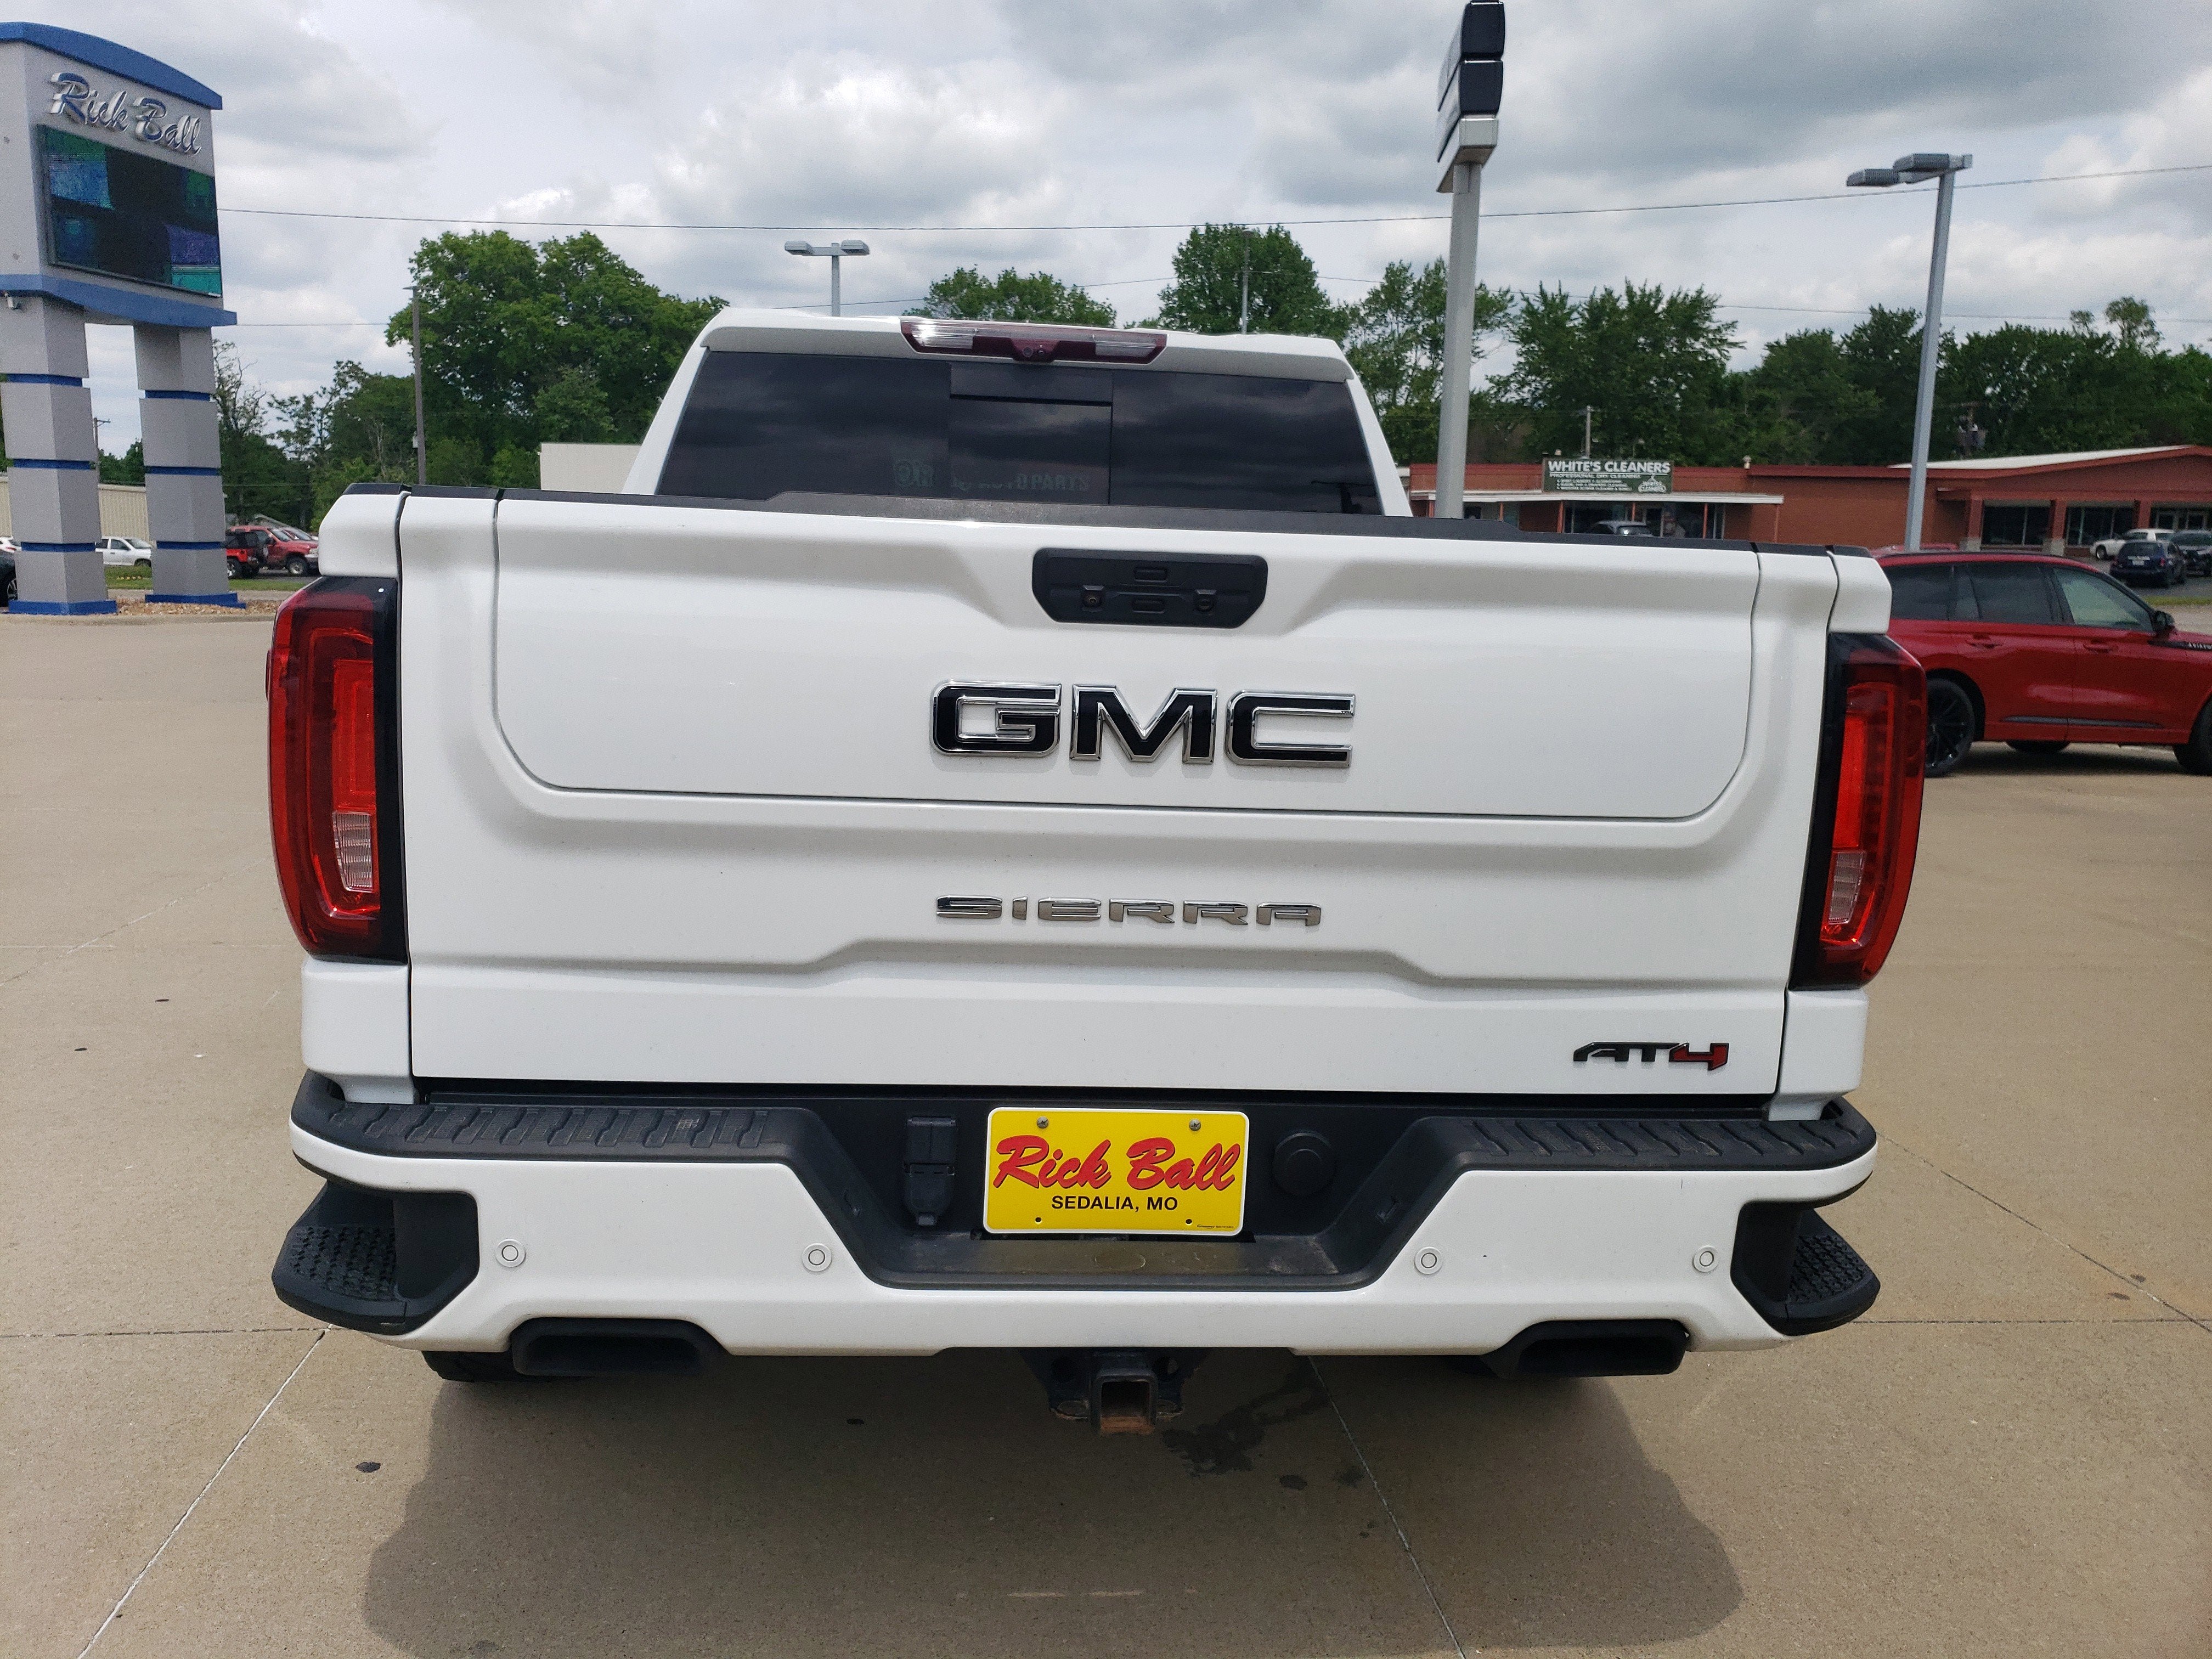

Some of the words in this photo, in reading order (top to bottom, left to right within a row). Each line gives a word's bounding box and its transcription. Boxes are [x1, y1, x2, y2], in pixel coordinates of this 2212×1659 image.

[50, 72, 129, 132] Rick
[133, 97, 201, 155] Ball
[1548, 460, 1601, 472] WHITE'S
[1604, 461, 1671, 473] CLEANERS
[929, 679, 1357, 768] GMC
[935, 895, 1323, 926] SIERRA
[1573, 1042, 1729, 1071] AT4
[992, 1135, 1111, 1189] Rick
[1126, 1137, 1240, 1190] Ball
[1051, 1195, 1139, 1212] SEDALIA,
[1147, 1197, 1178, 1211] MO
